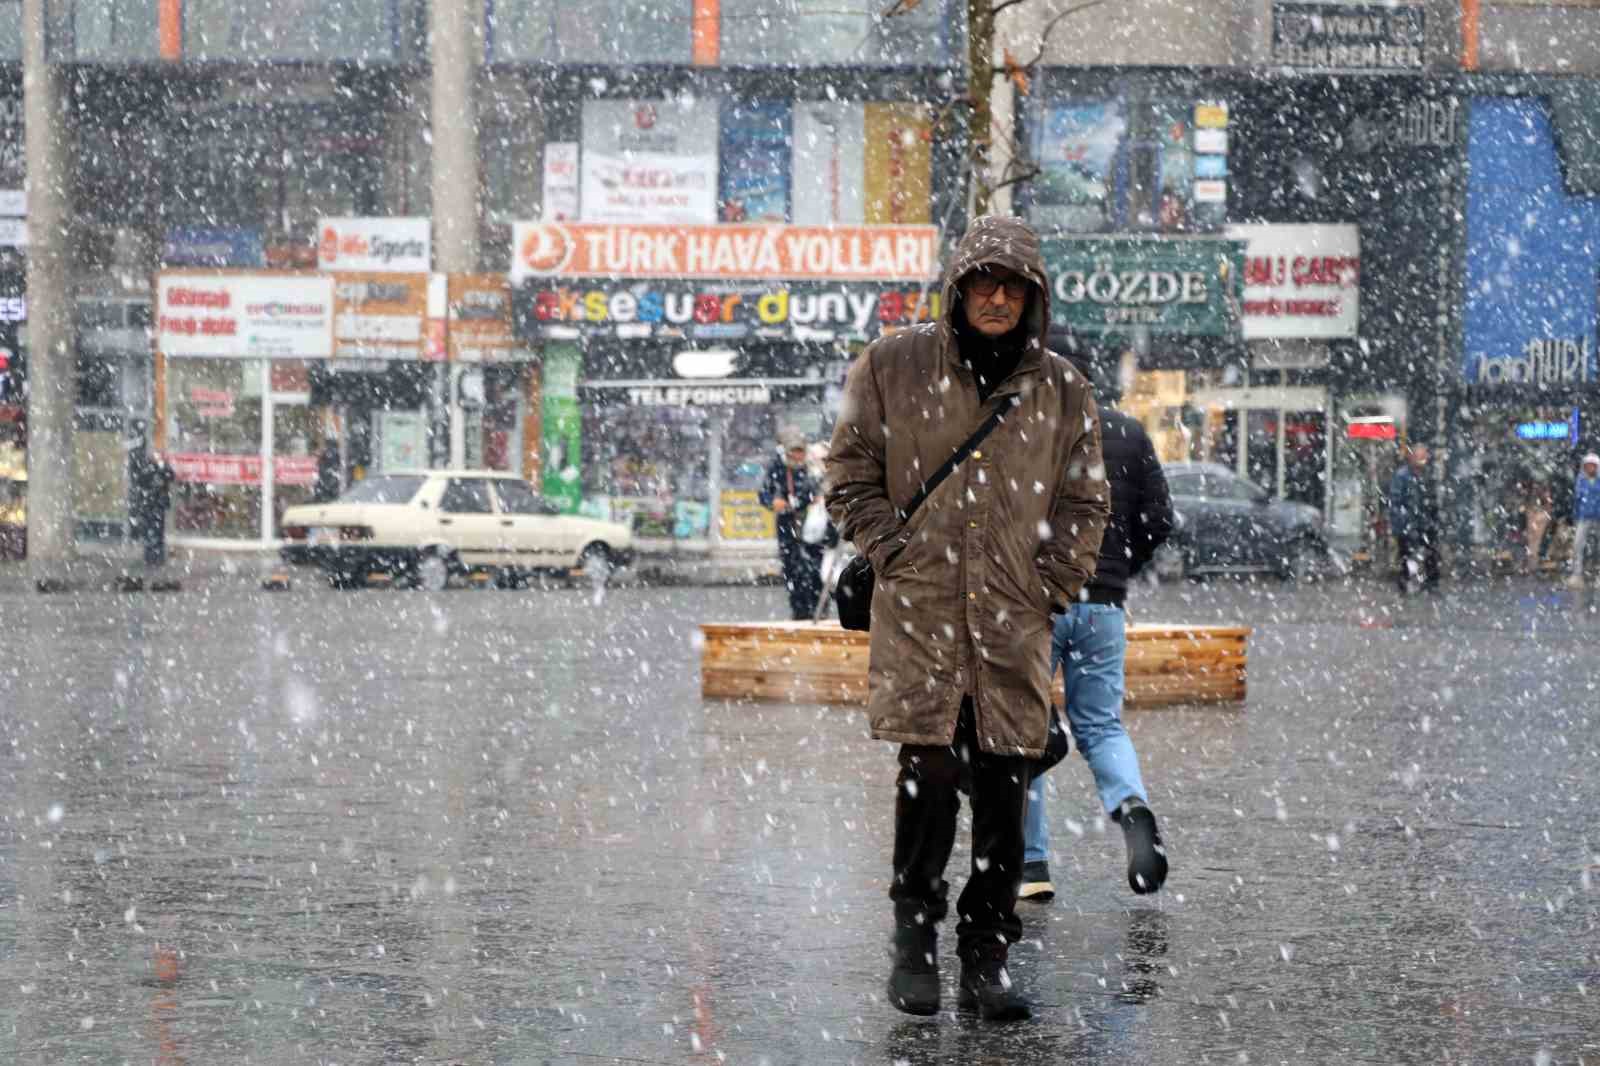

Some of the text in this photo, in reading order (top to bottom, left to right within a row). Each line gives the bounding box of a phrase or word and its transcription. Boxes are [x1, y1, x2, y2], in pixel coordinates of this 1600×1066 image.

[587, 227, 931, 274] TÜRK HAVA YOLLARI
[1055, 255, 1208, 303] GÖZDE
[628, 387, 771, 405] TELEFONCUM
